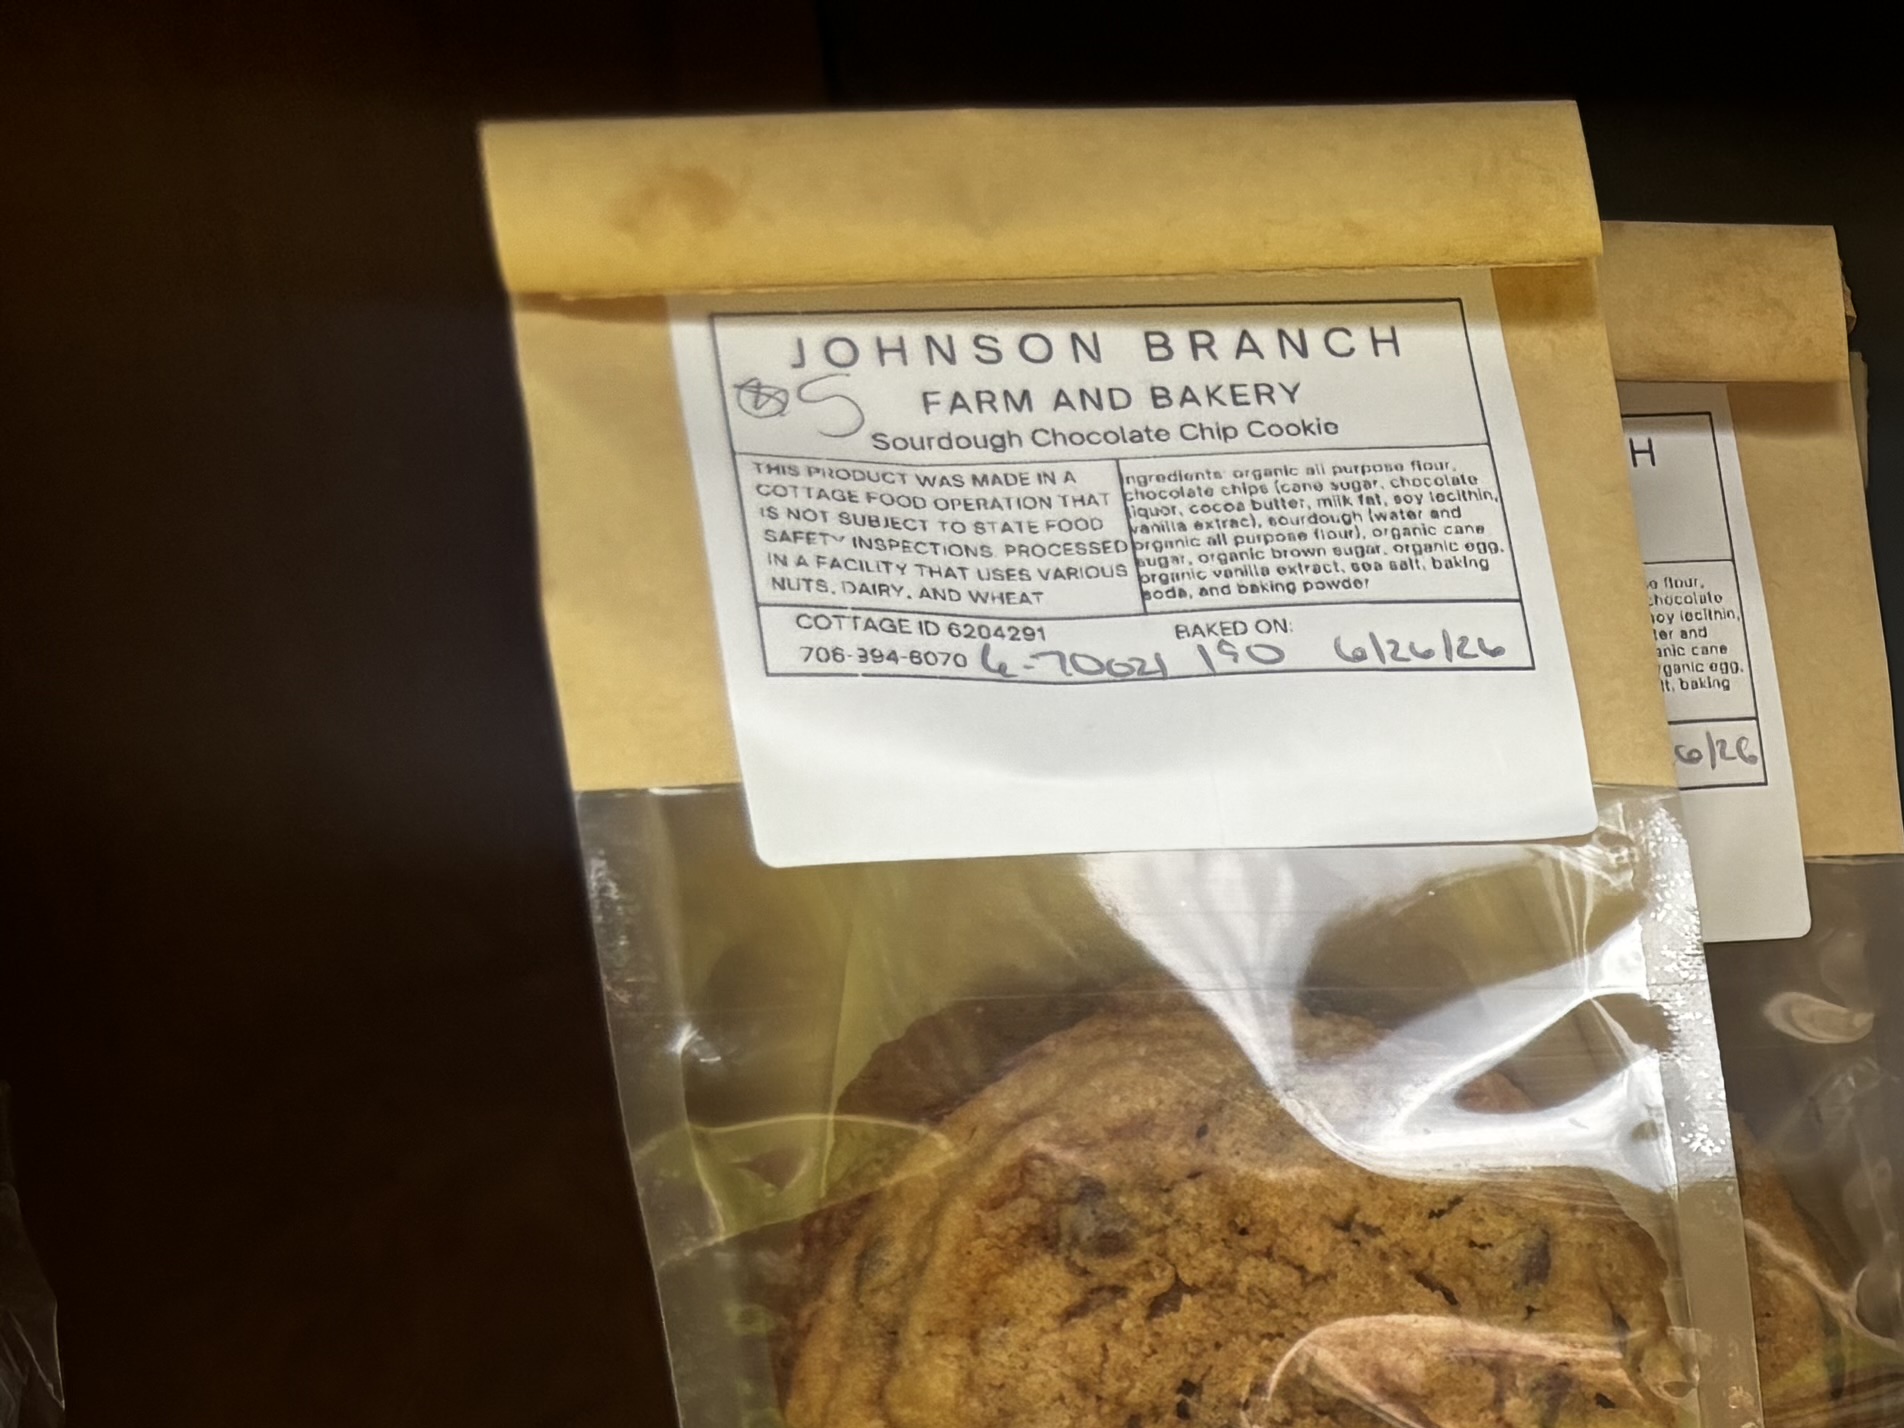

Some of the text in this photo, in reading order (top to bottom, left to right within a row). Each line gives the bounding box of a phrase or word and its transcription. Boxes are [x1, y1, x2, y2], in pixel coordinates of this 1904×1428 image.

[789, 323, 1402, 370] JOHNSON BRANCH
[920, 380, 1302, 417] FARM AND BAKERY
[870, 416, 1340, 453] Sourdough Chocolate Chip Cookie
[1173, 617, 1295, 641] BAKED ON:
